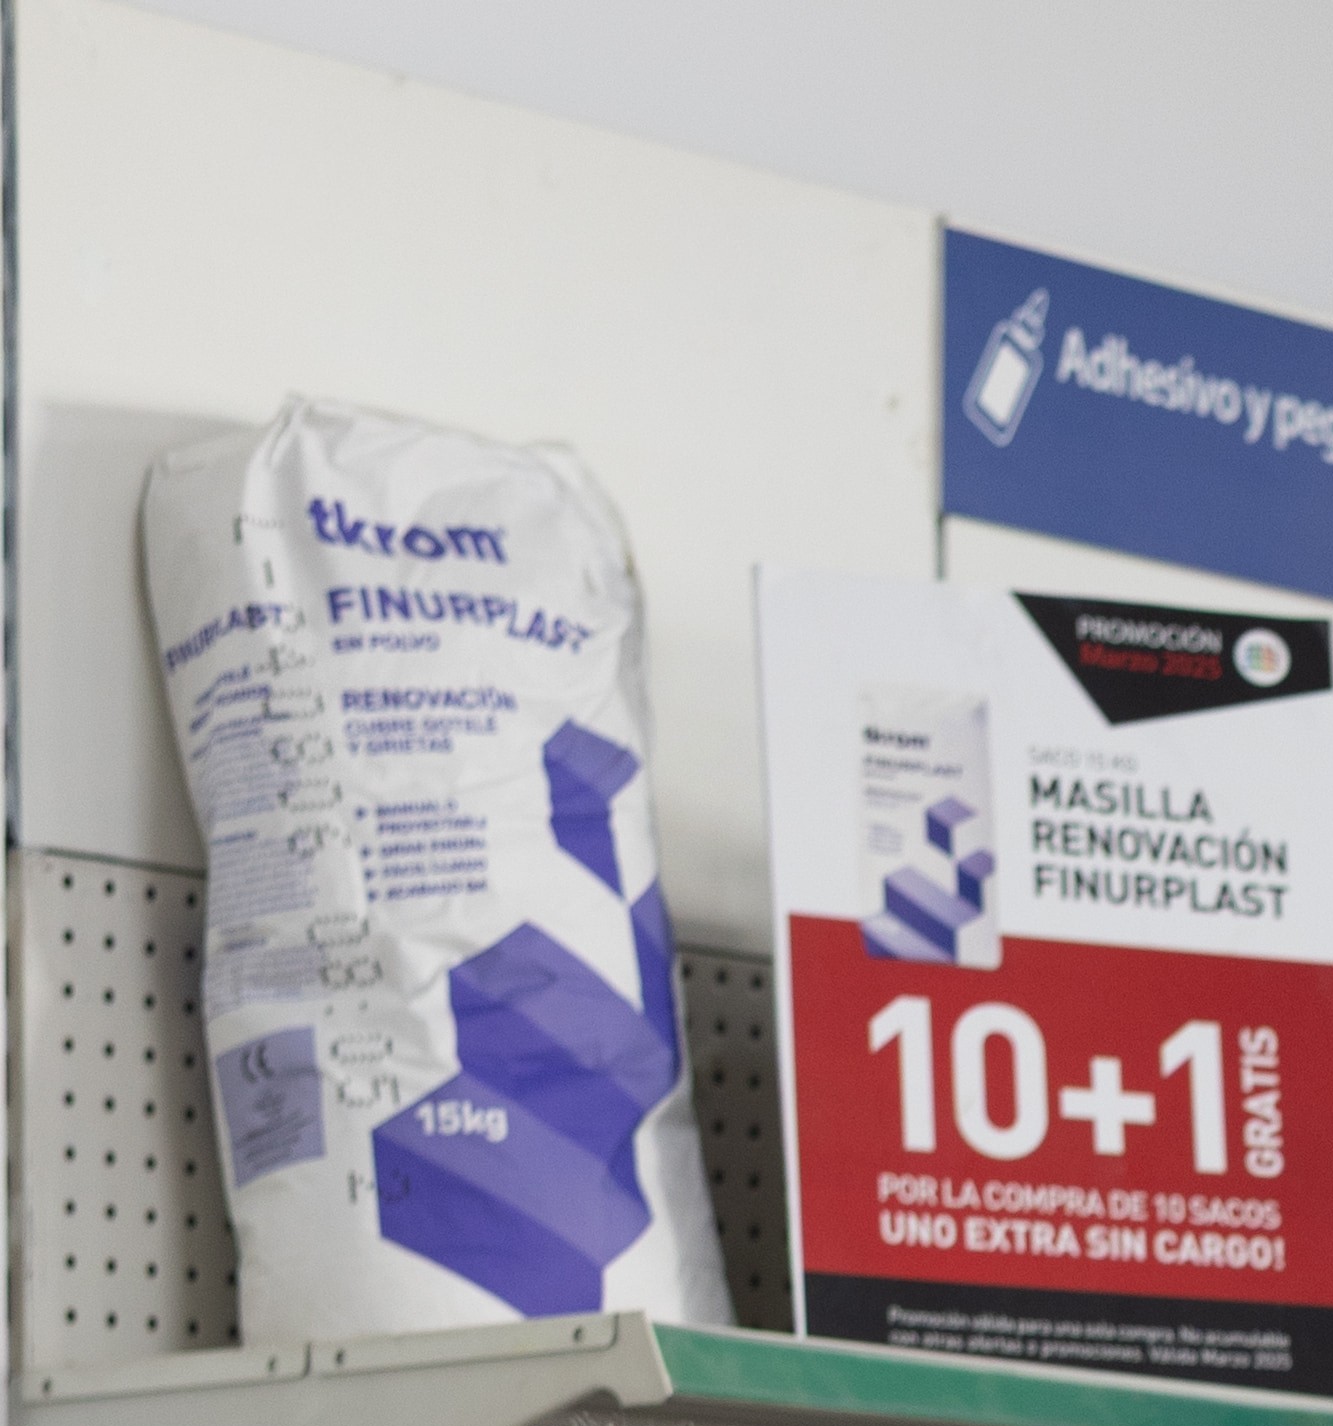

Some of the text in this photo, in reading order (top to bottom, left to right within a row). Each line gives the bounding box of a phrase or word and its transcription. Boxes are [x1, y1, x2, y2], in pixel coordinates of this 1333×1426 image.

[1056, 326, 1240, 424] Adhesivo
[1240, 388, 1274, 443] y
[309, 498, 507, 564] tkrom
[327, 586, 593, 654] FINURPLAST
[1076, 614, 1222, 653] PROMOCIÓN
[1079, 644, 1158, 676] Marzo
[1030, 774, 1213, 824] MASILLA
[1031, 819, 1288, 875] RENOVACIÓN
[1034, 864, 1289, 919] FINURPLAST
[868, 995, 1228, 1174] 10+1
[1239, 1025, 1284, 1178] GRATIS
[416, 1103, 508, 1142] 15kg
[878, 1172, 1280, 1229] POR LA COMPRA DE 10 SACOS
[880, 1213, 1285, 1271] UNO EXTRA SIN CARGO!
